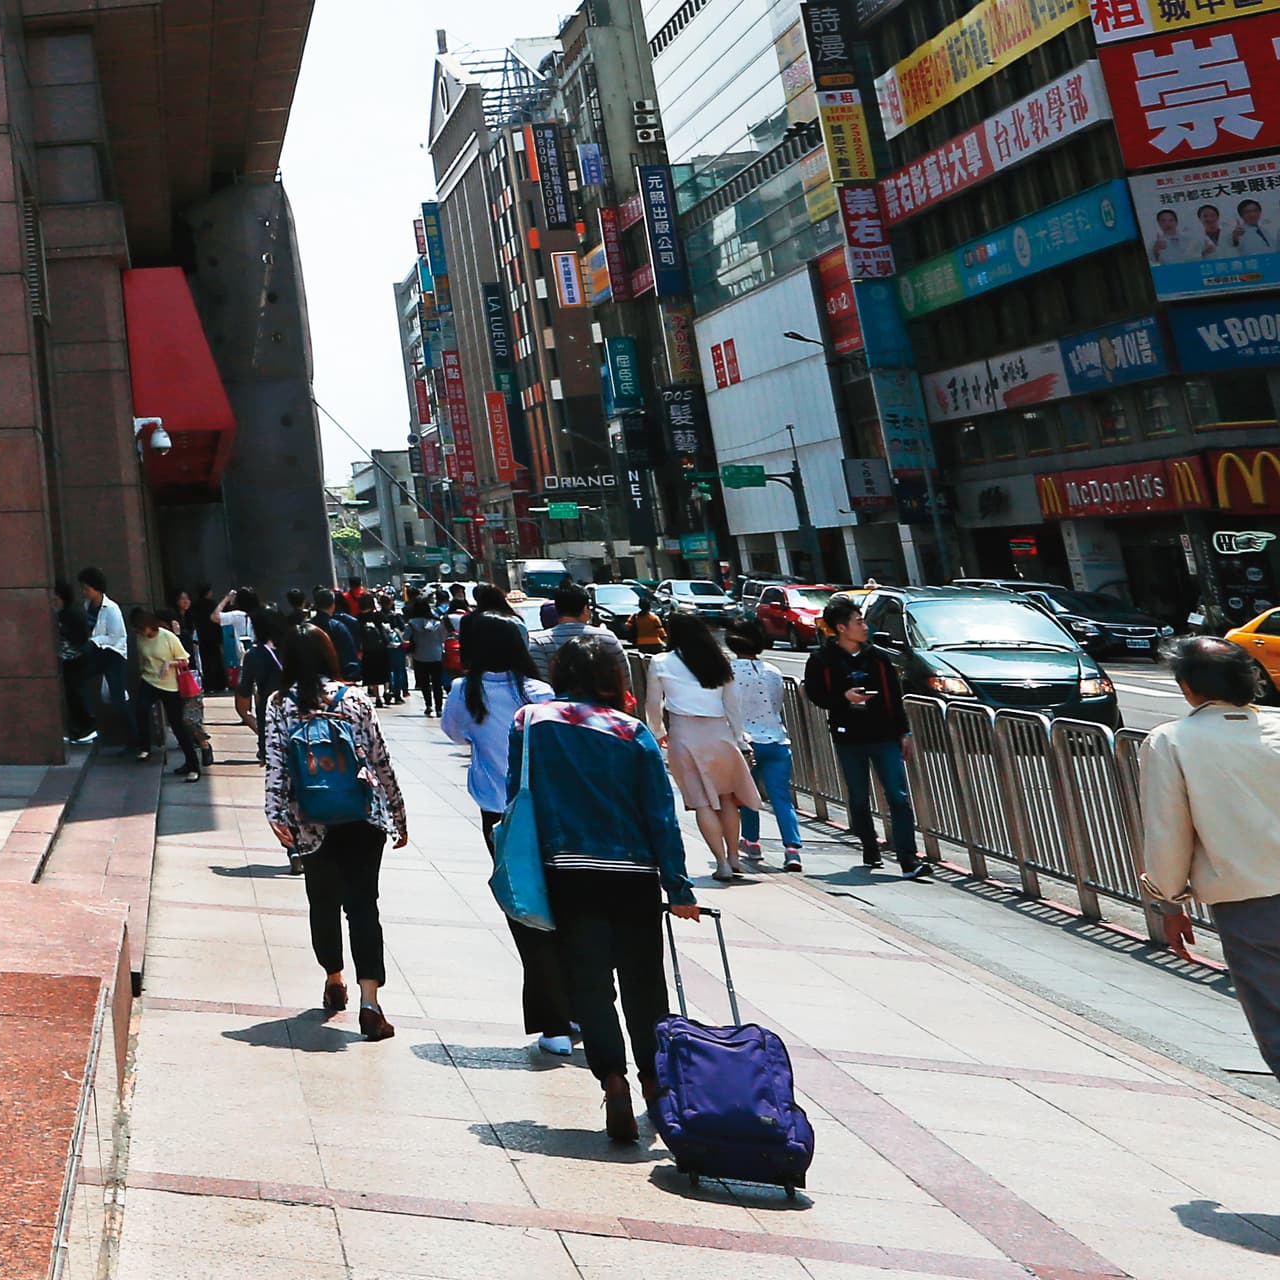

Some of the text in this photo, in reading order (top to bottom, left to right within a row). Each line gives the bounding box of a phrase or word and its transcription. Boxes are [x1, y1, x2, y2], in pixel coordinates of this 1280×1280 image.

[807, 6, 849, 64] 詩漫
[1132, 33, 1280, 155] 崇
[647, 175, 676, 266] 元照出版公司
[843, 187, 884, 245] 崇右
[1196, 314, 1280, 352] K-BOO
[663, 389, 694, 401] DOS
[491, 404, 511, 471] ORANGE
[544, 474, 620, 489] ORANG
[627, 470, 642, 510] NET
[1065, 473, 1165, 507] McDonald's
